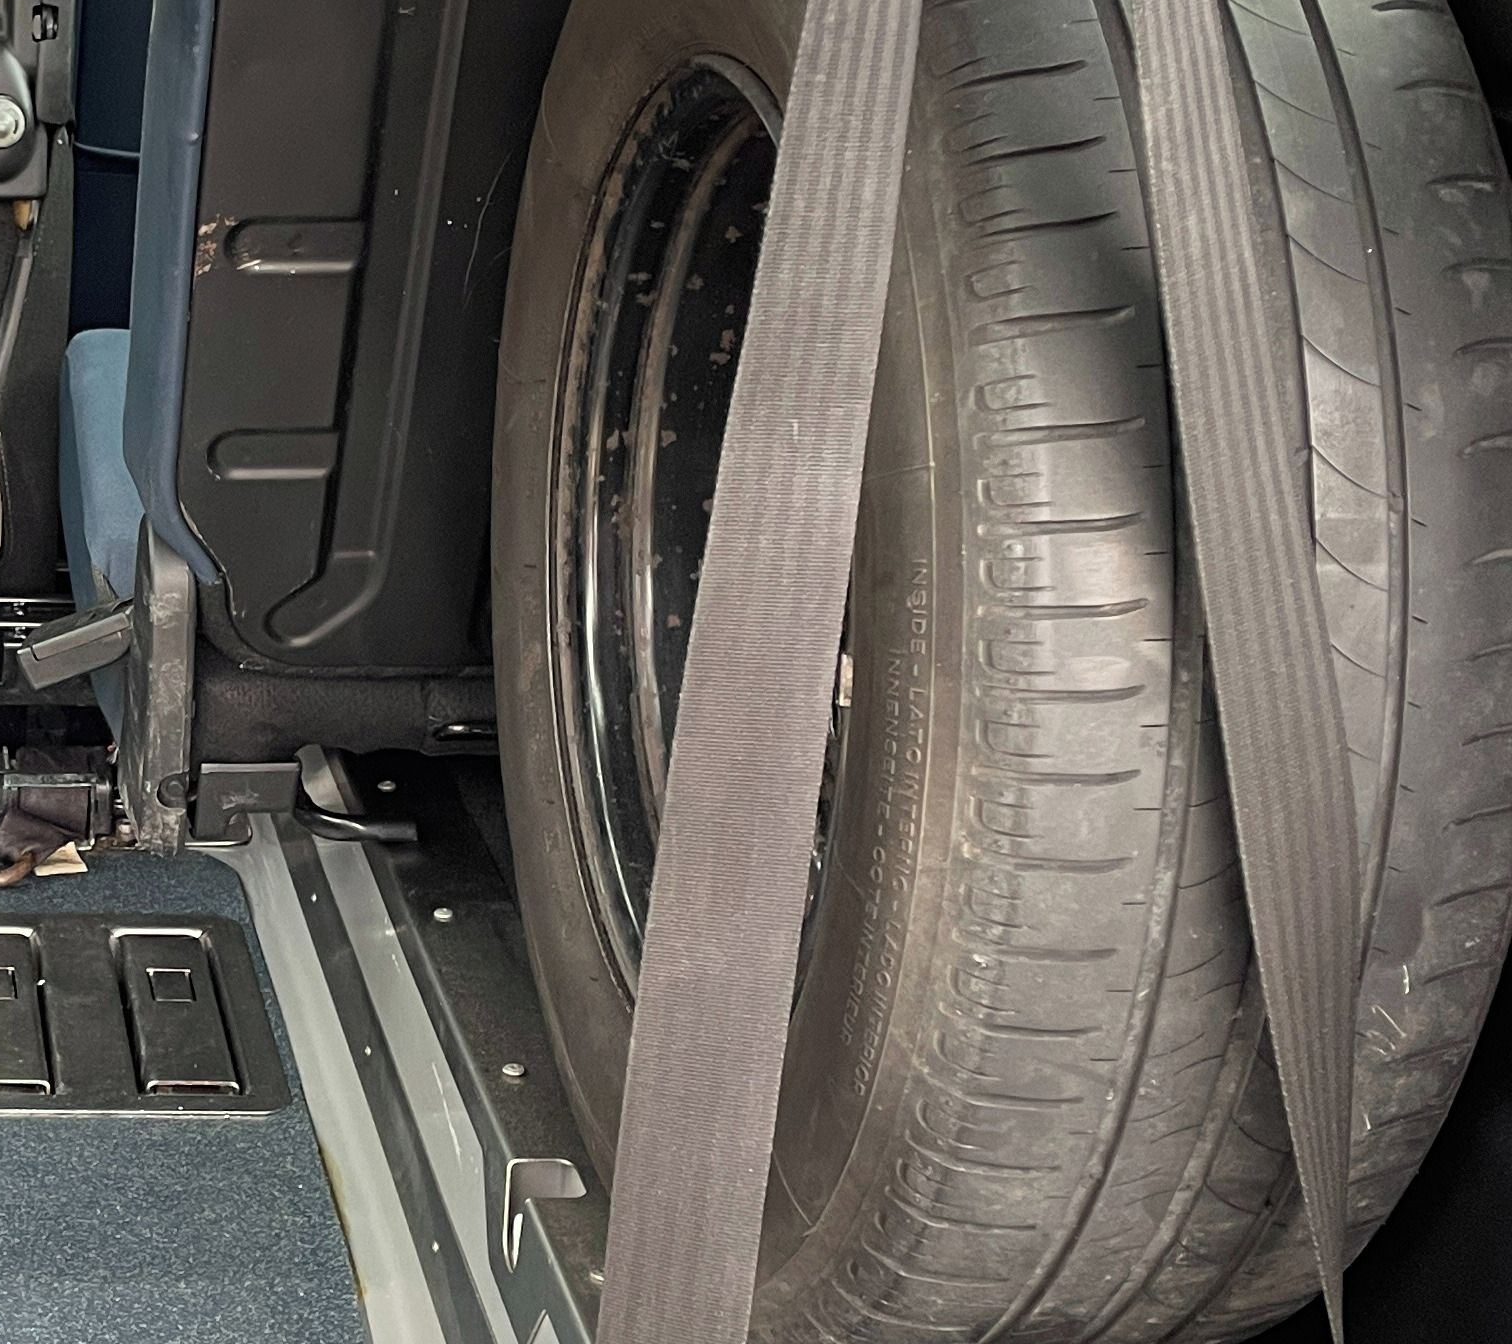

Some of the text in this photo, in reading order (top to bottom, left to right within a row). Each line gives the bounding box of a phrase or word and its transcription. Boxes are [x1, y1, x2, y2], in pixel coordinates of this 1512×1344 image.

[910, 558, 928, 656] INSIDE
[877, 648, 902, 819] INNENSEITE
[905, 686, 926, 764] LATO
